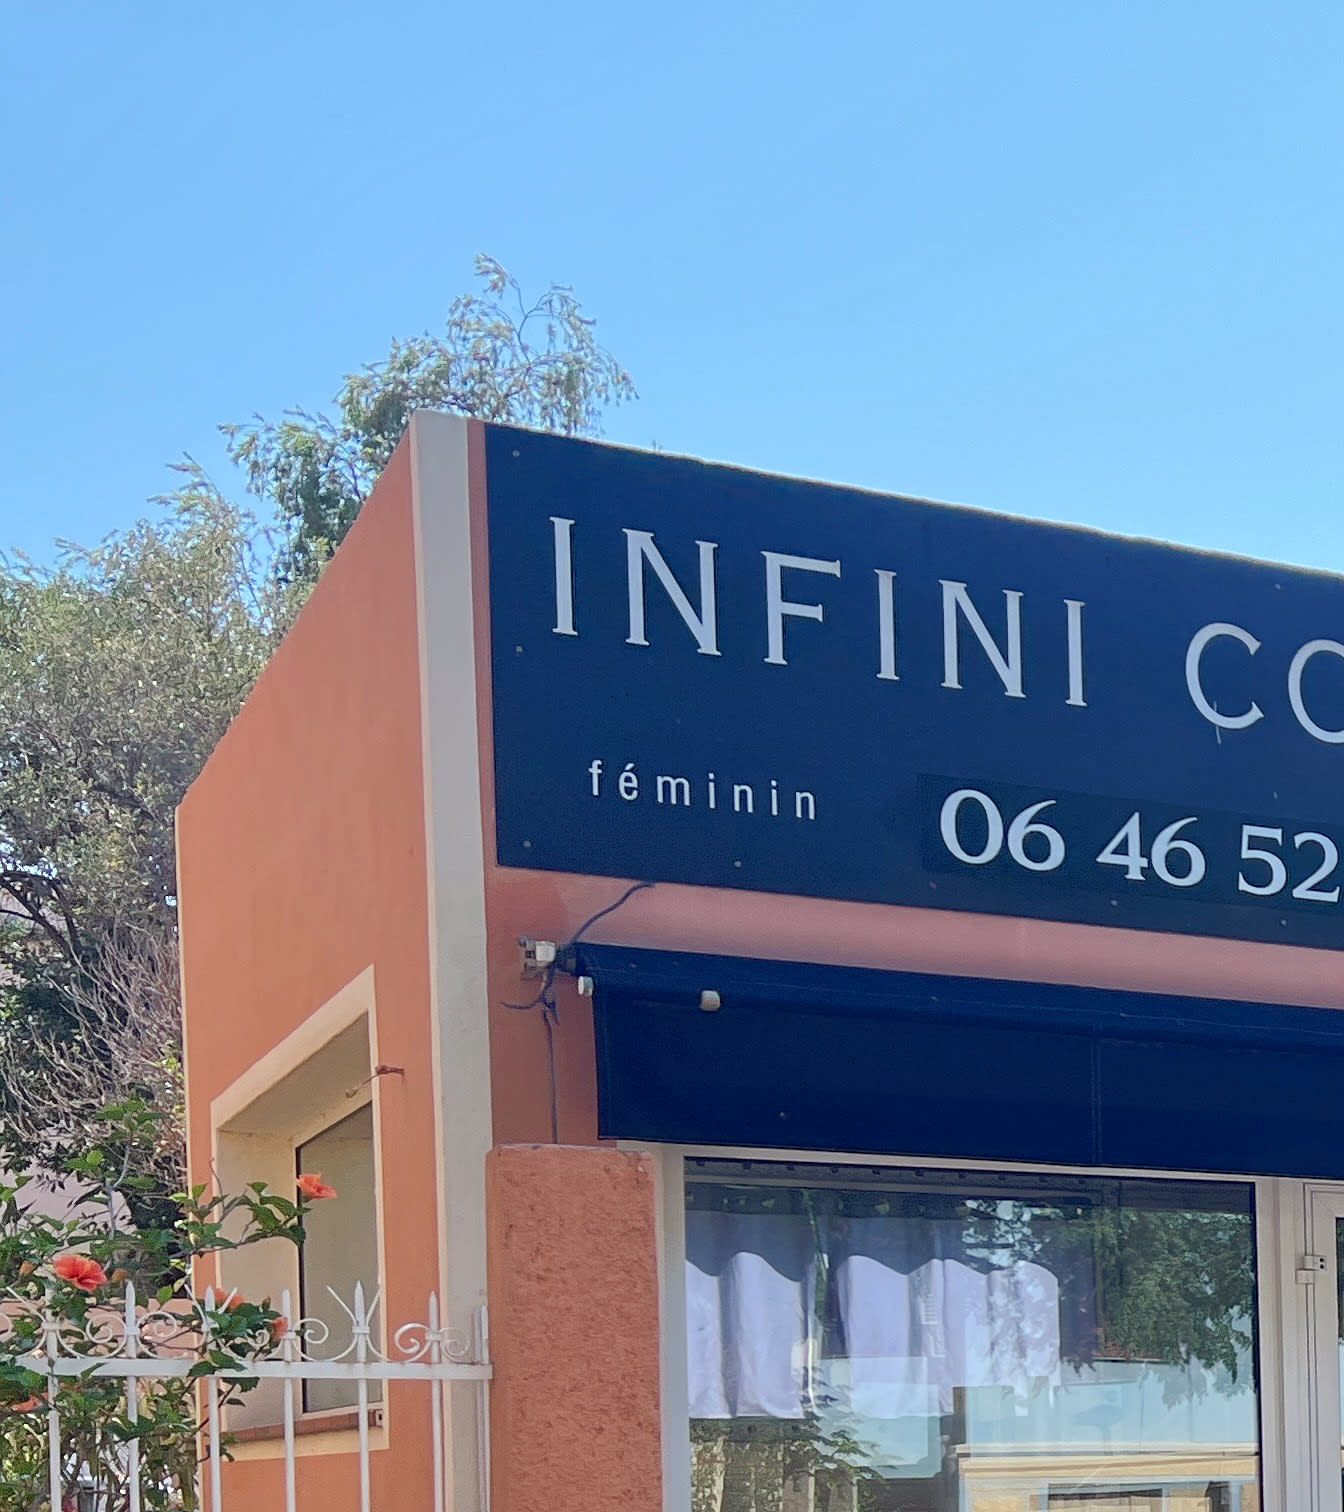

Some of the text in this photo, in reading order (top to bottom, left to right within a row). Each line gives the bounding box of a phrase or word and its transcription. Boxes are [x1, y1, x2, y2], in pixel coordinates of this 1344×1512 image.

[550, 516, 1087, 707] INFINI
[588, 759, 816, 820] féminin
[940, 789, 1066, 872] 06
[1096, 811, 1206, 886] 46
[1238, 825, 1340, 903] 52
